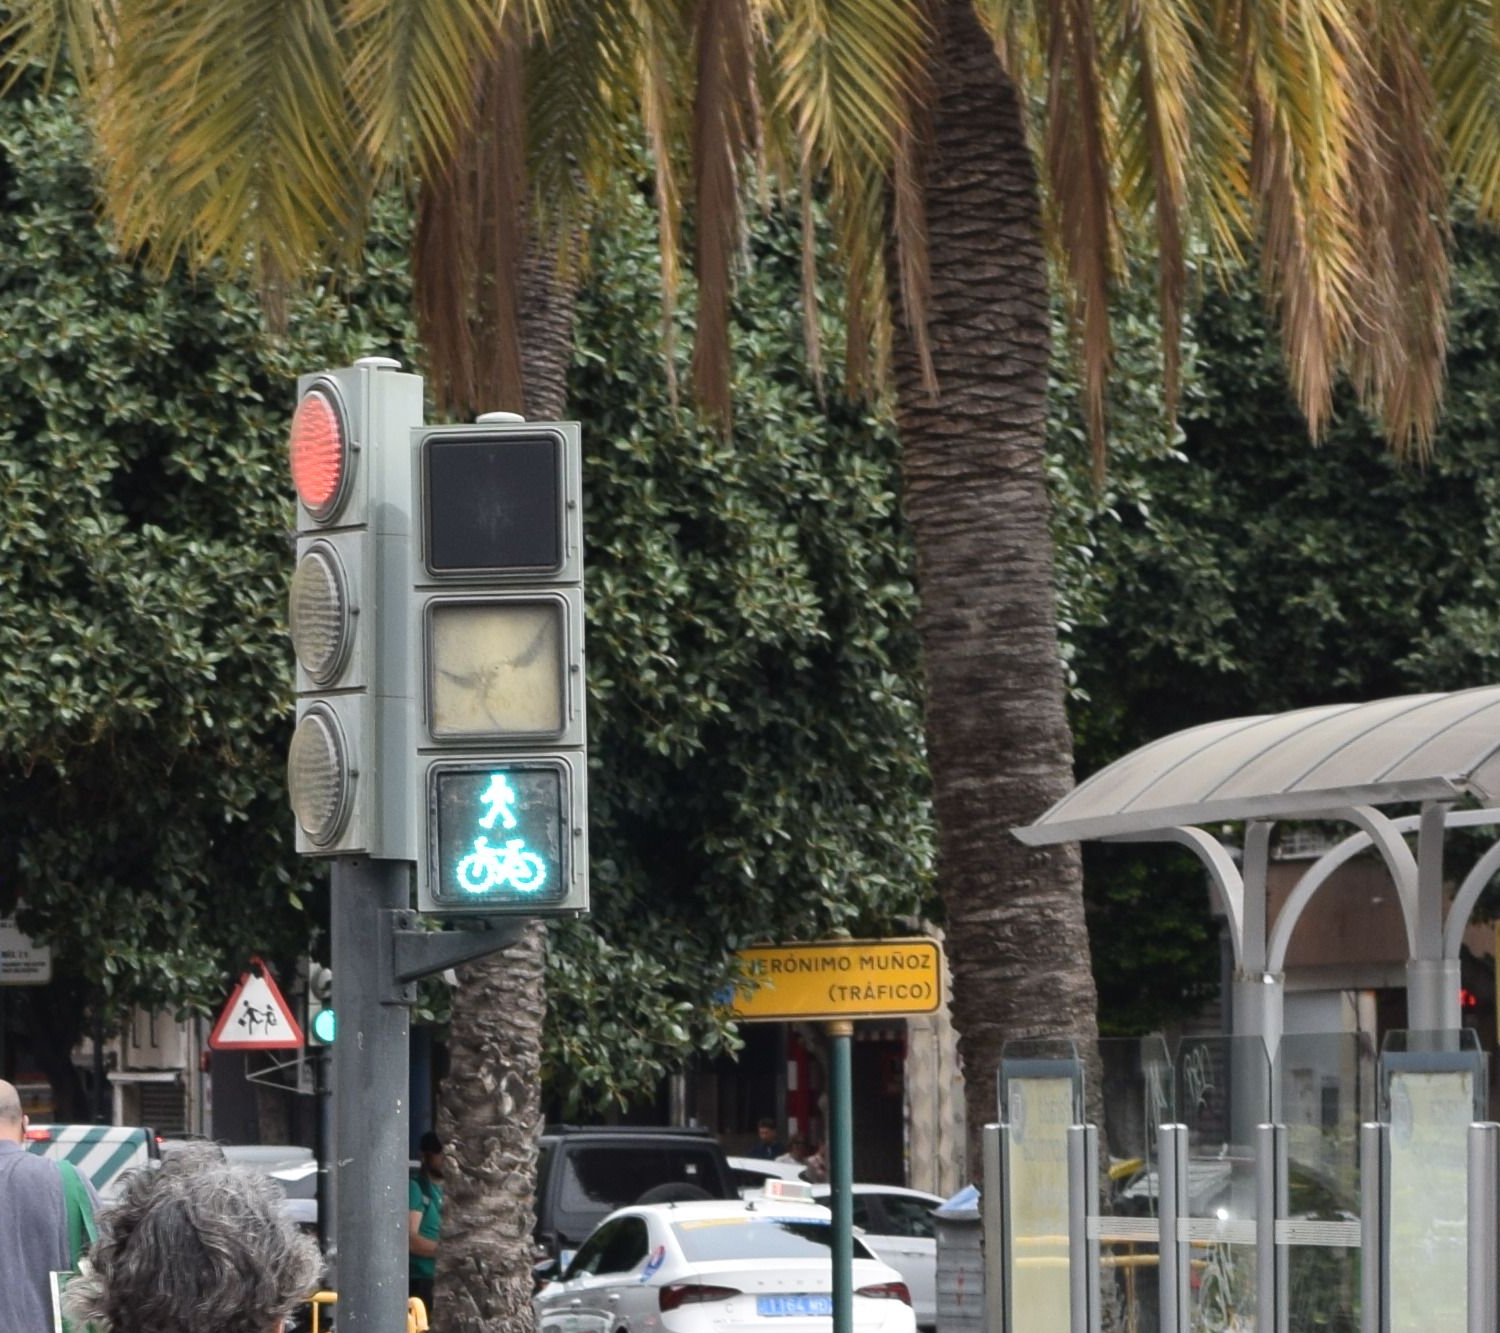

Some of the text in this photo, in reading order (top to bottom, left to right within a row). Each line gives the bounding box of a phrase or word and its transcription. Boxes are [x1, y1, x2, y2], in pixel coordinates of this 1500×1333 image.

[750, 952, 931, 977] JERÓNIMO MUÑOZ
[828, 981, 932, 1003] (TRÁFICO)
